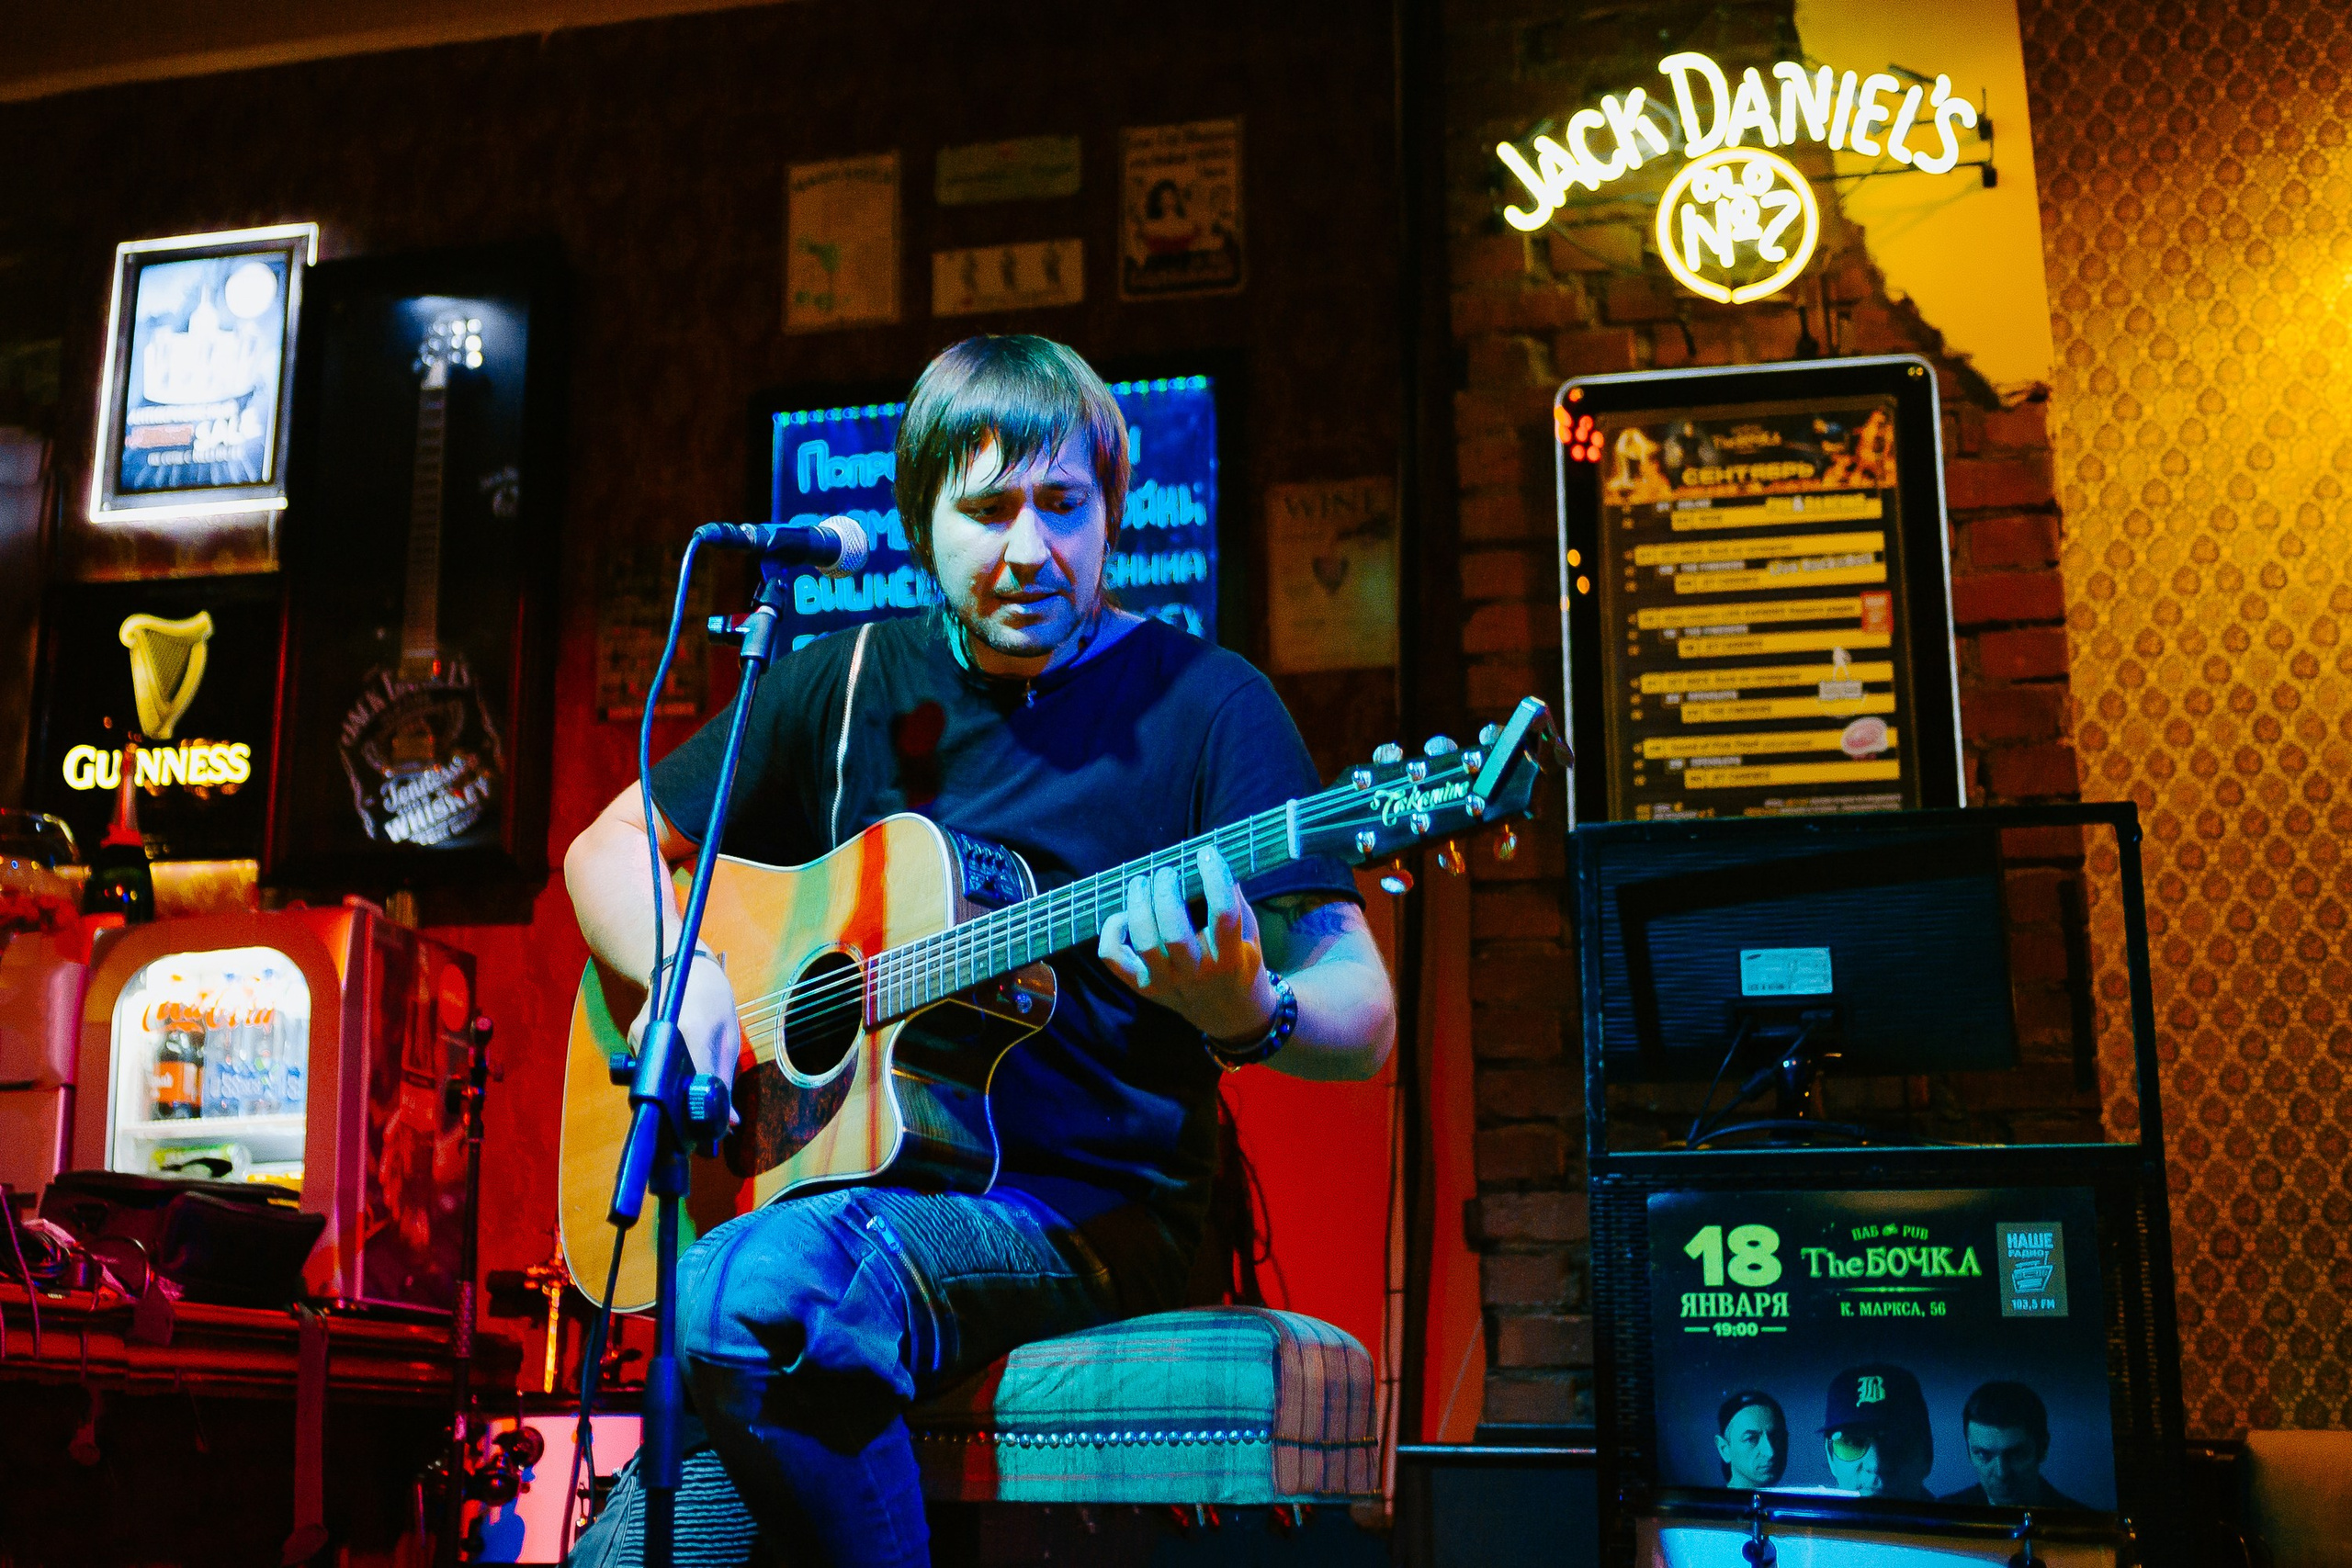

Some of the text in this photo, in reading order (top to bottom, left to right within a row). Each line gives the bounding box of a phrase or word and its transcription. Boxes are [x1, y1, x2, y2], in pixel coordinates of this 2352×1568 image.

[1497, 51, 1979, 231] JACK DANIEL'S
[62, 743, 251, 791] GUNNESS
[1851, 1224, 1929, 1241] ПАБ PUB
[2007, 1232, 2054, 1249] НАШЕ
[1683, 1224, 1782, 1287] 18
[2007, 1249, 2045, 1259] РАДИО
[1679, 1292, 1790, 1318] ЯНВАРЯ
[1840, 1300, 1947, 1318] К. МАРКСА, 56
[2040, 1298, 2056, 1310] FM
[1713, 1322, 1759, 1337] 19:00
